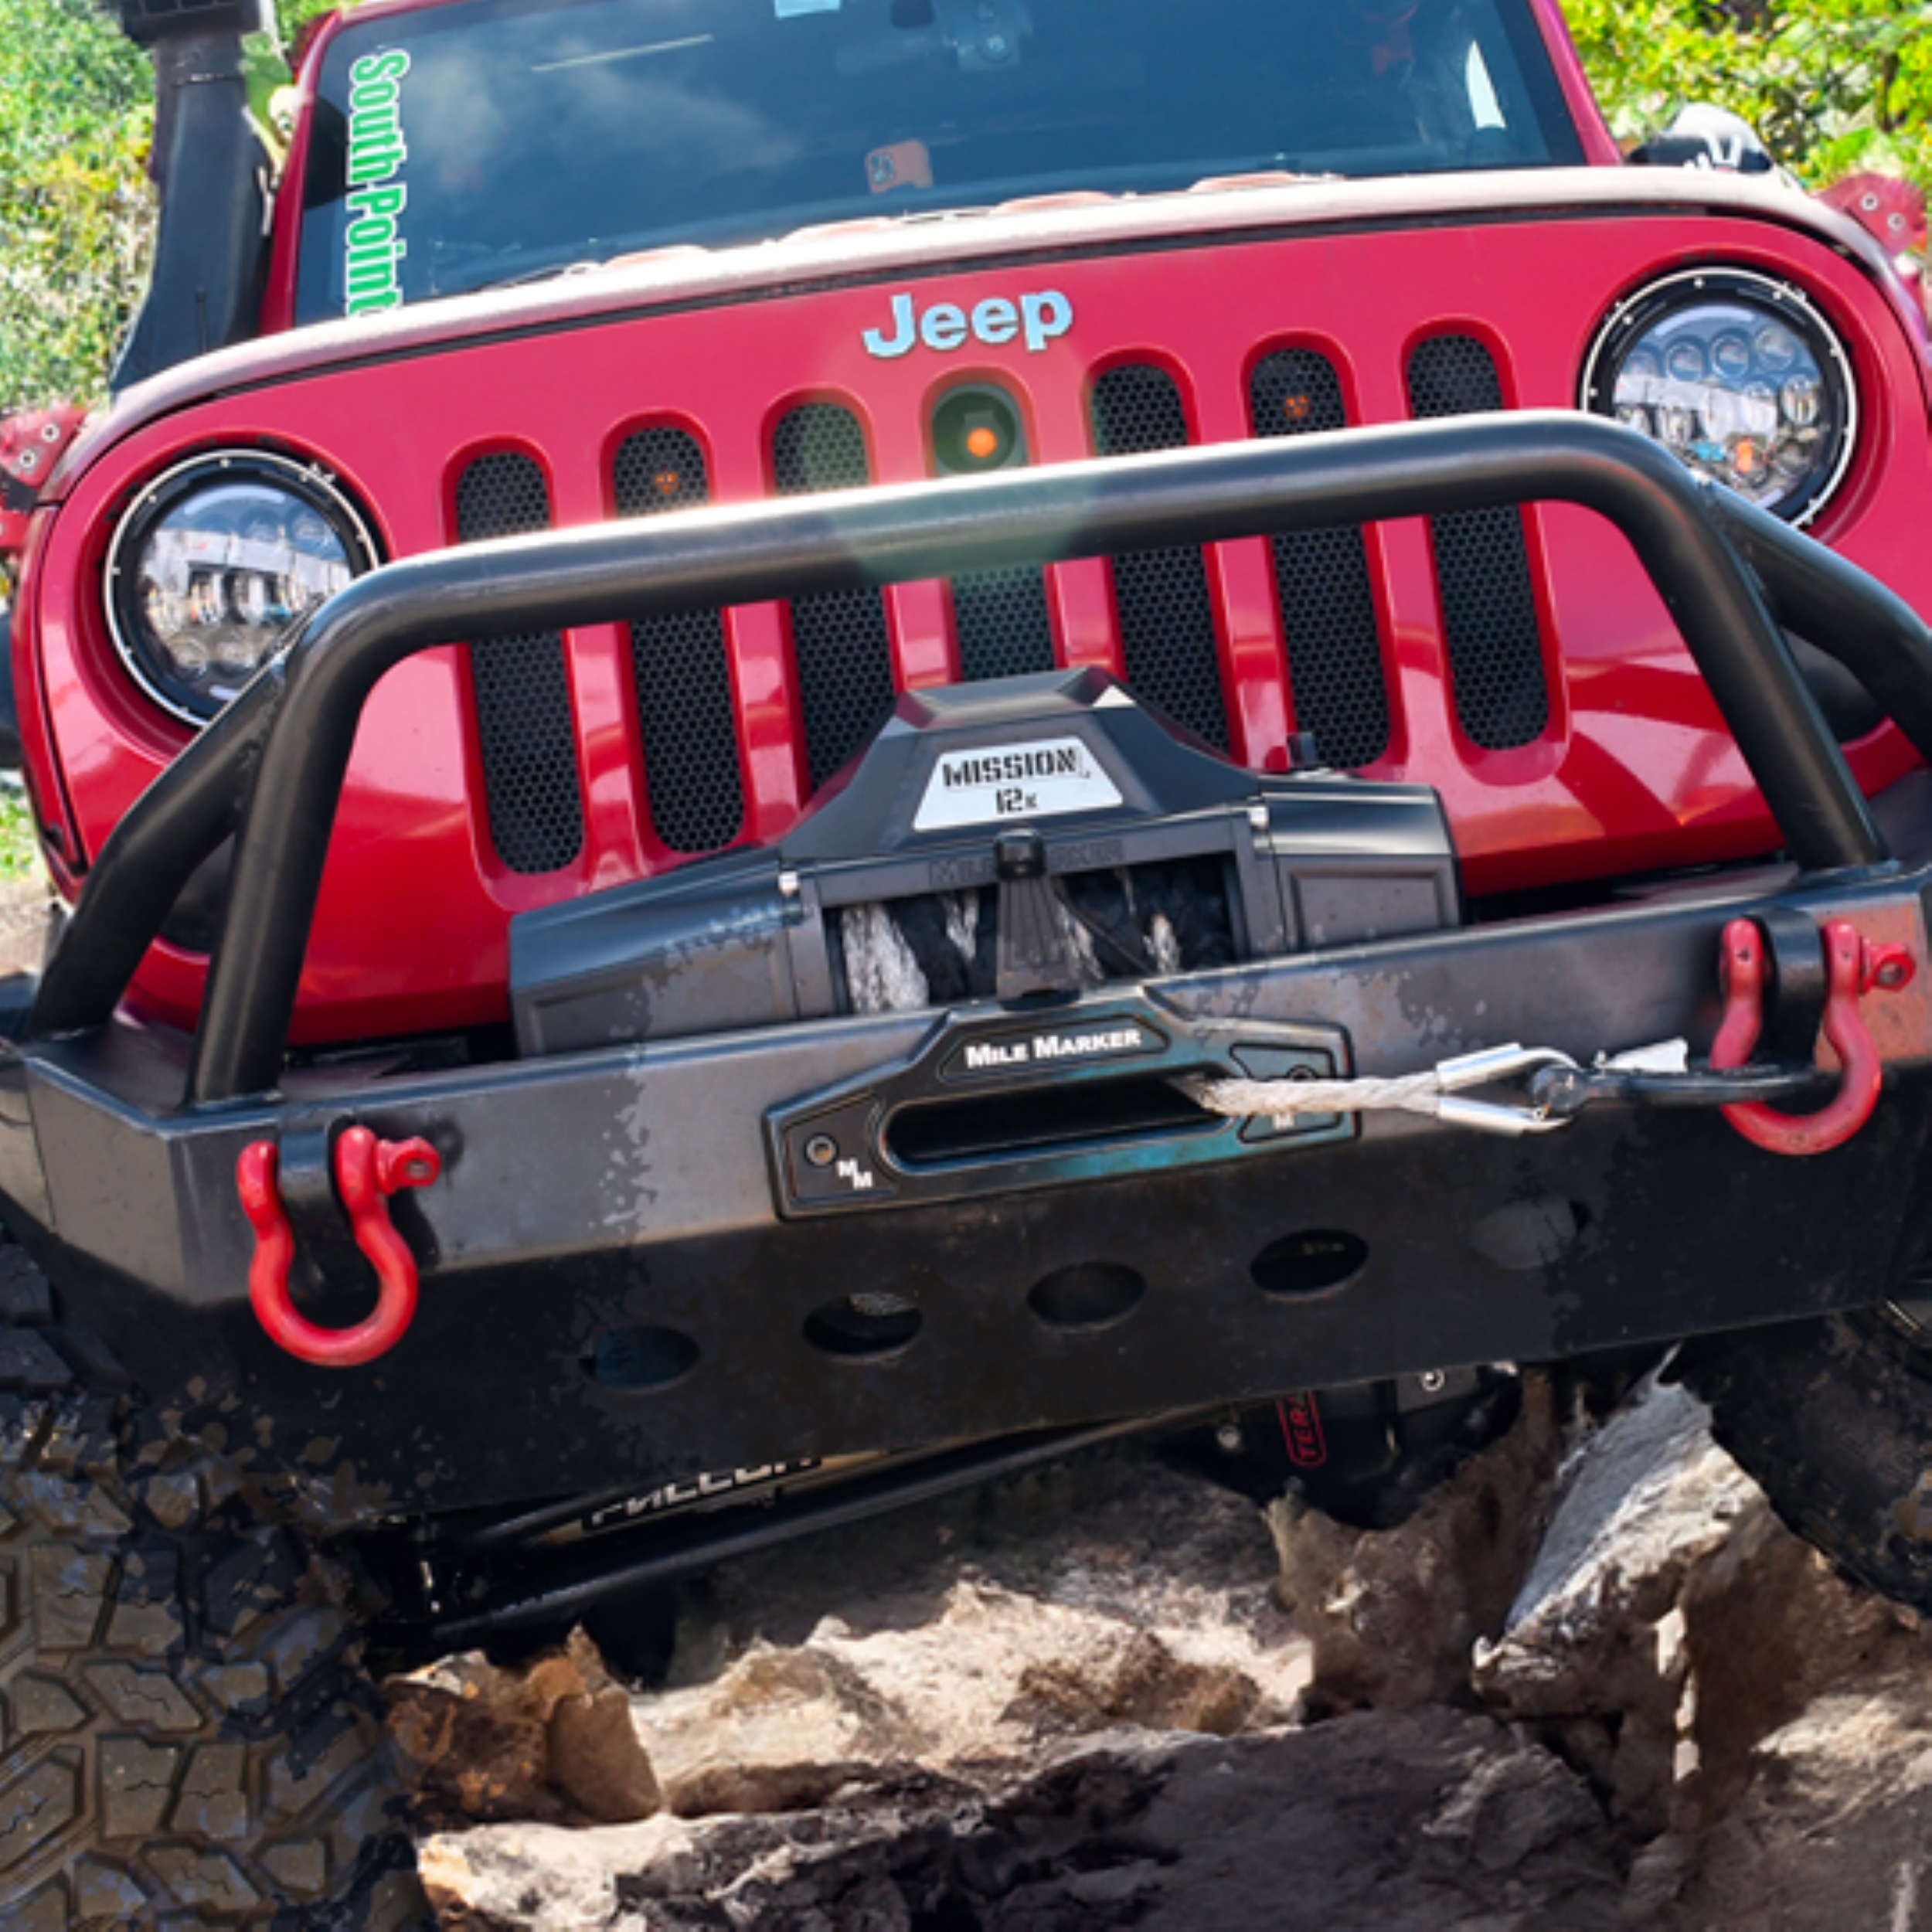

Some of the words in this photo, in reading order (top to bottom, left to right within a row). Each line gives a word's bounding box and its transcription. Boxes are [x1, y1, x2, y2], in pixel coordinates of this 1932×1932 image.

[348, 49, 411, 185] South
[346, 182, 407, 316] Point
[862, 290, 1073, 359] Jeep
[942, 747, 1077, 787] MISSION
[965, 1043, 1029, 1069] MILE
[1032, 1028, 1141, 1060] MARKER
[1285, 1394, 1317, 1459] TER
